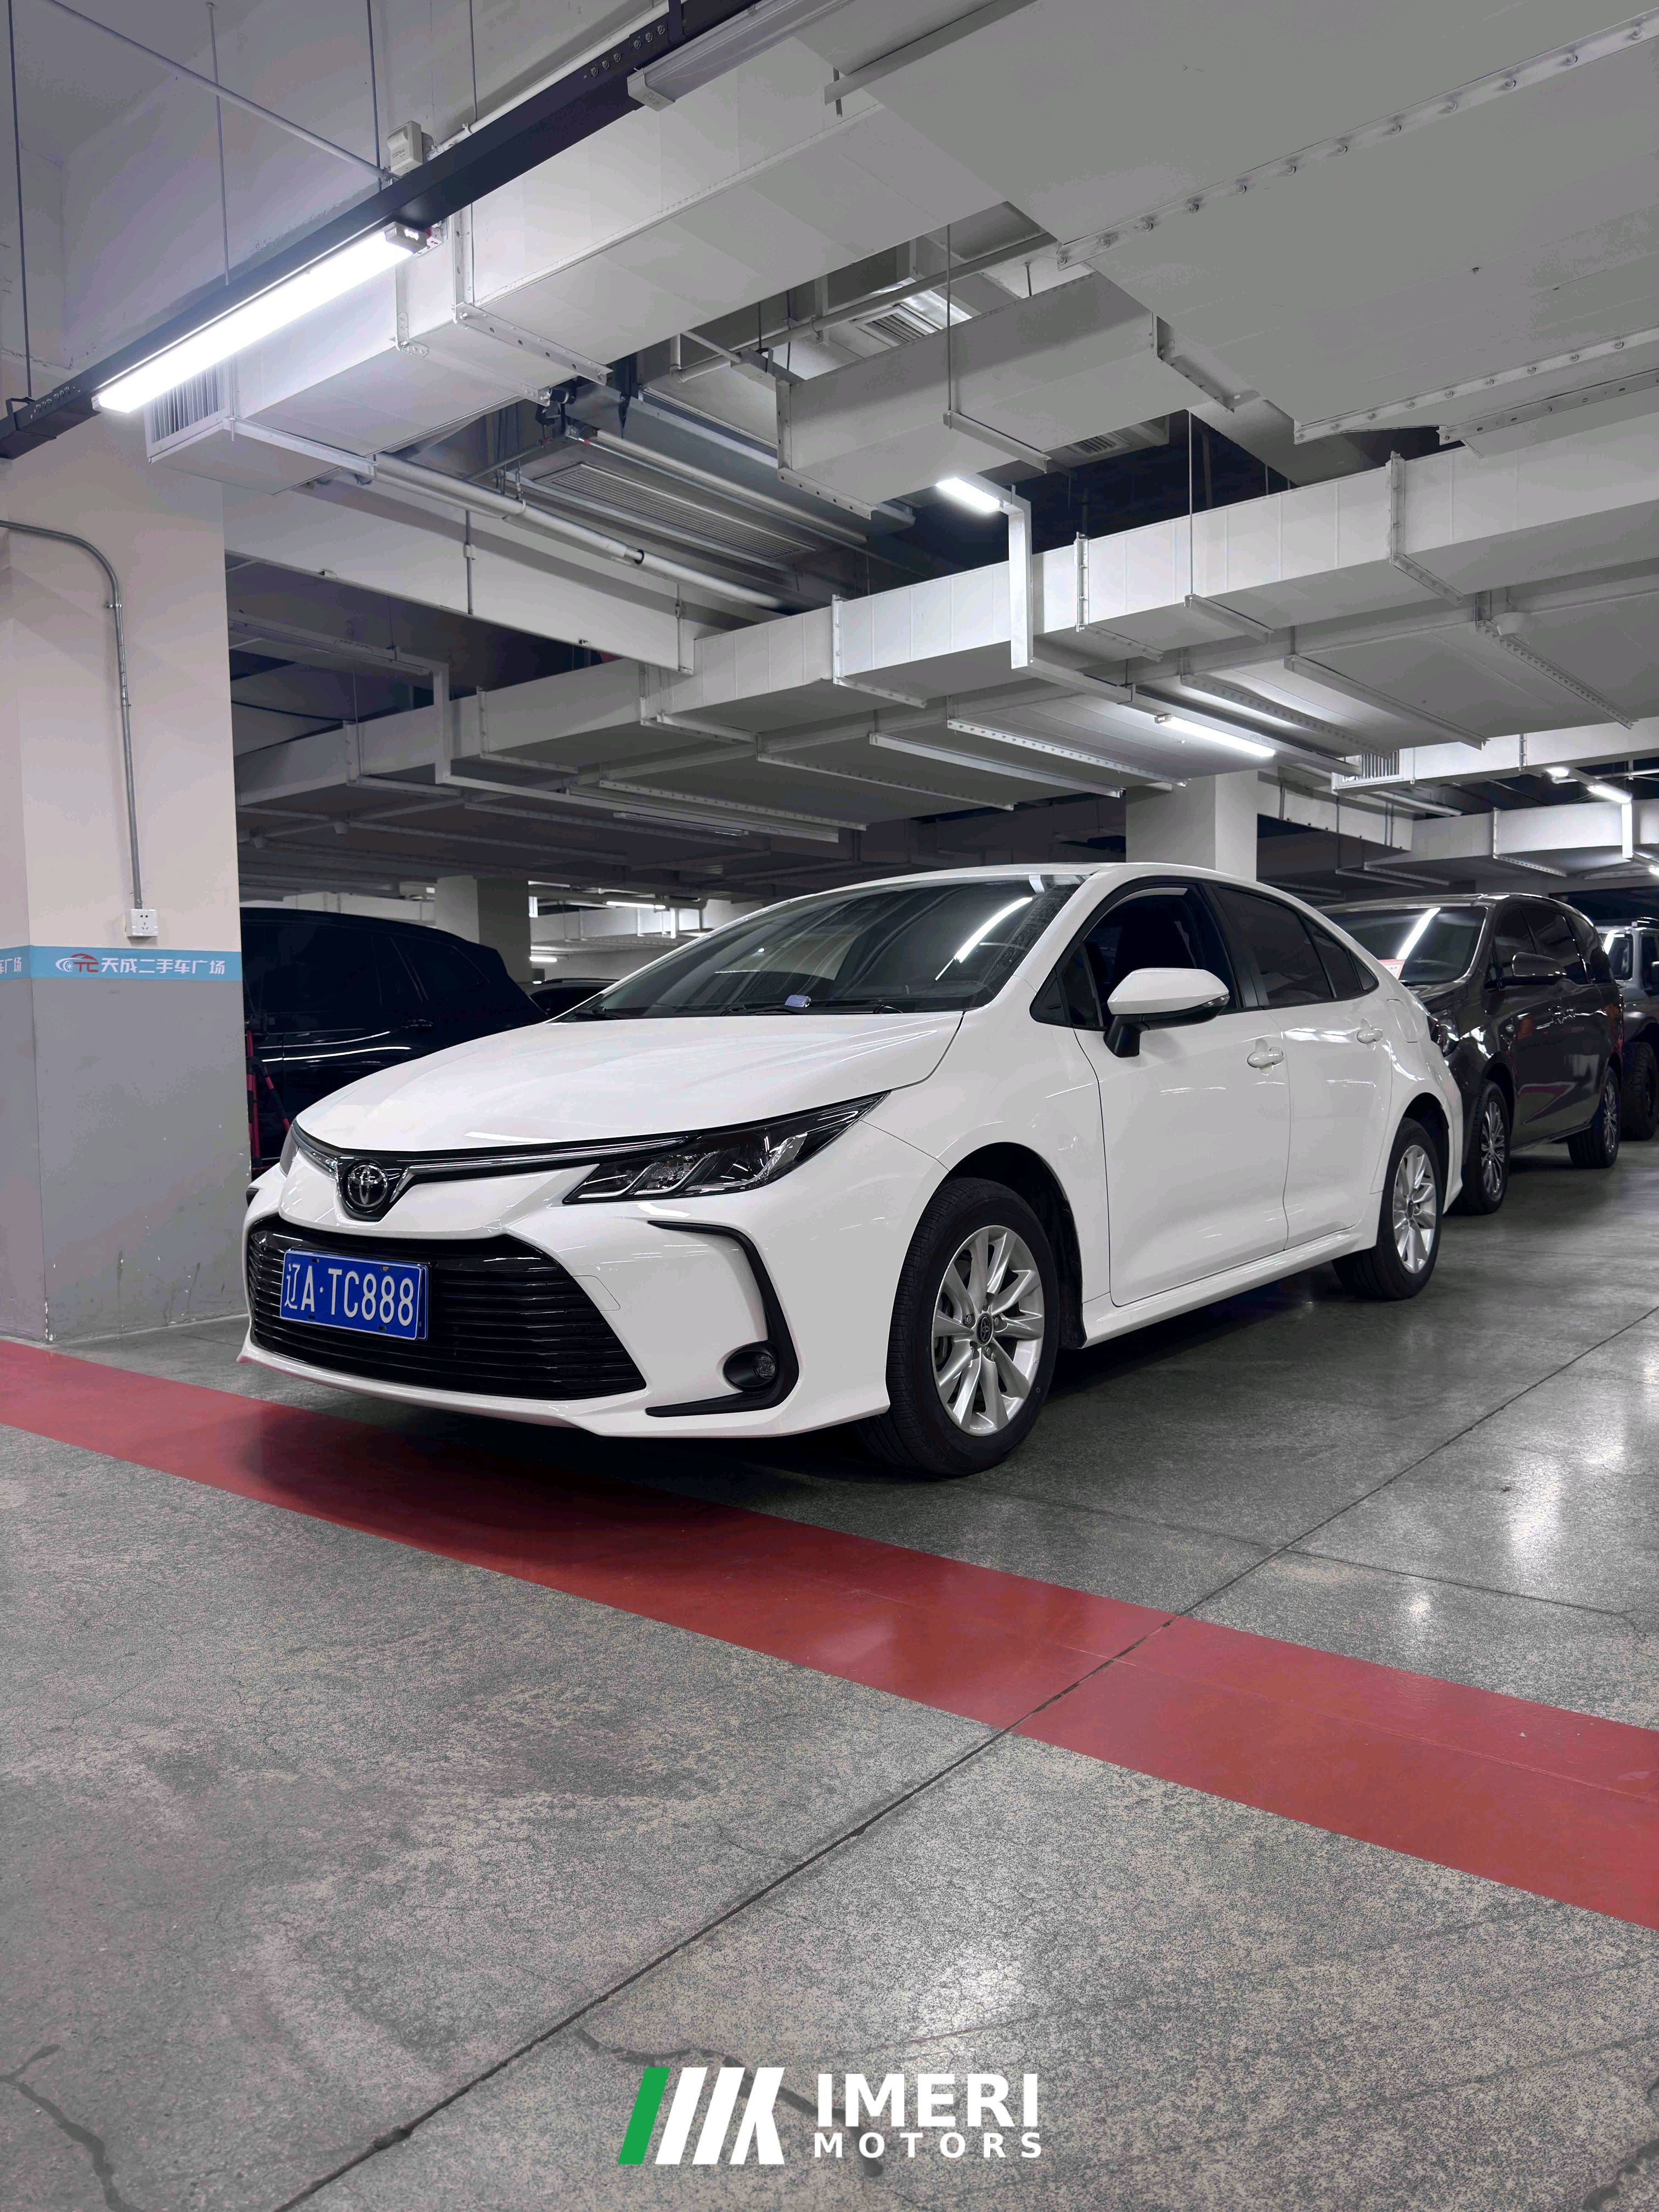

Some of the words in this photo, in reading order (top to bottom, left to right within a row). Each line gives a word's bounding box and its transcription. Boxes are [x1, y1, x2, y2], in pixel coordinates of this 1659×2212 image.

[101, 957, 225, 975] 天成二手车广场
[284, 1263, 414, 1327] 辽A·TC888
